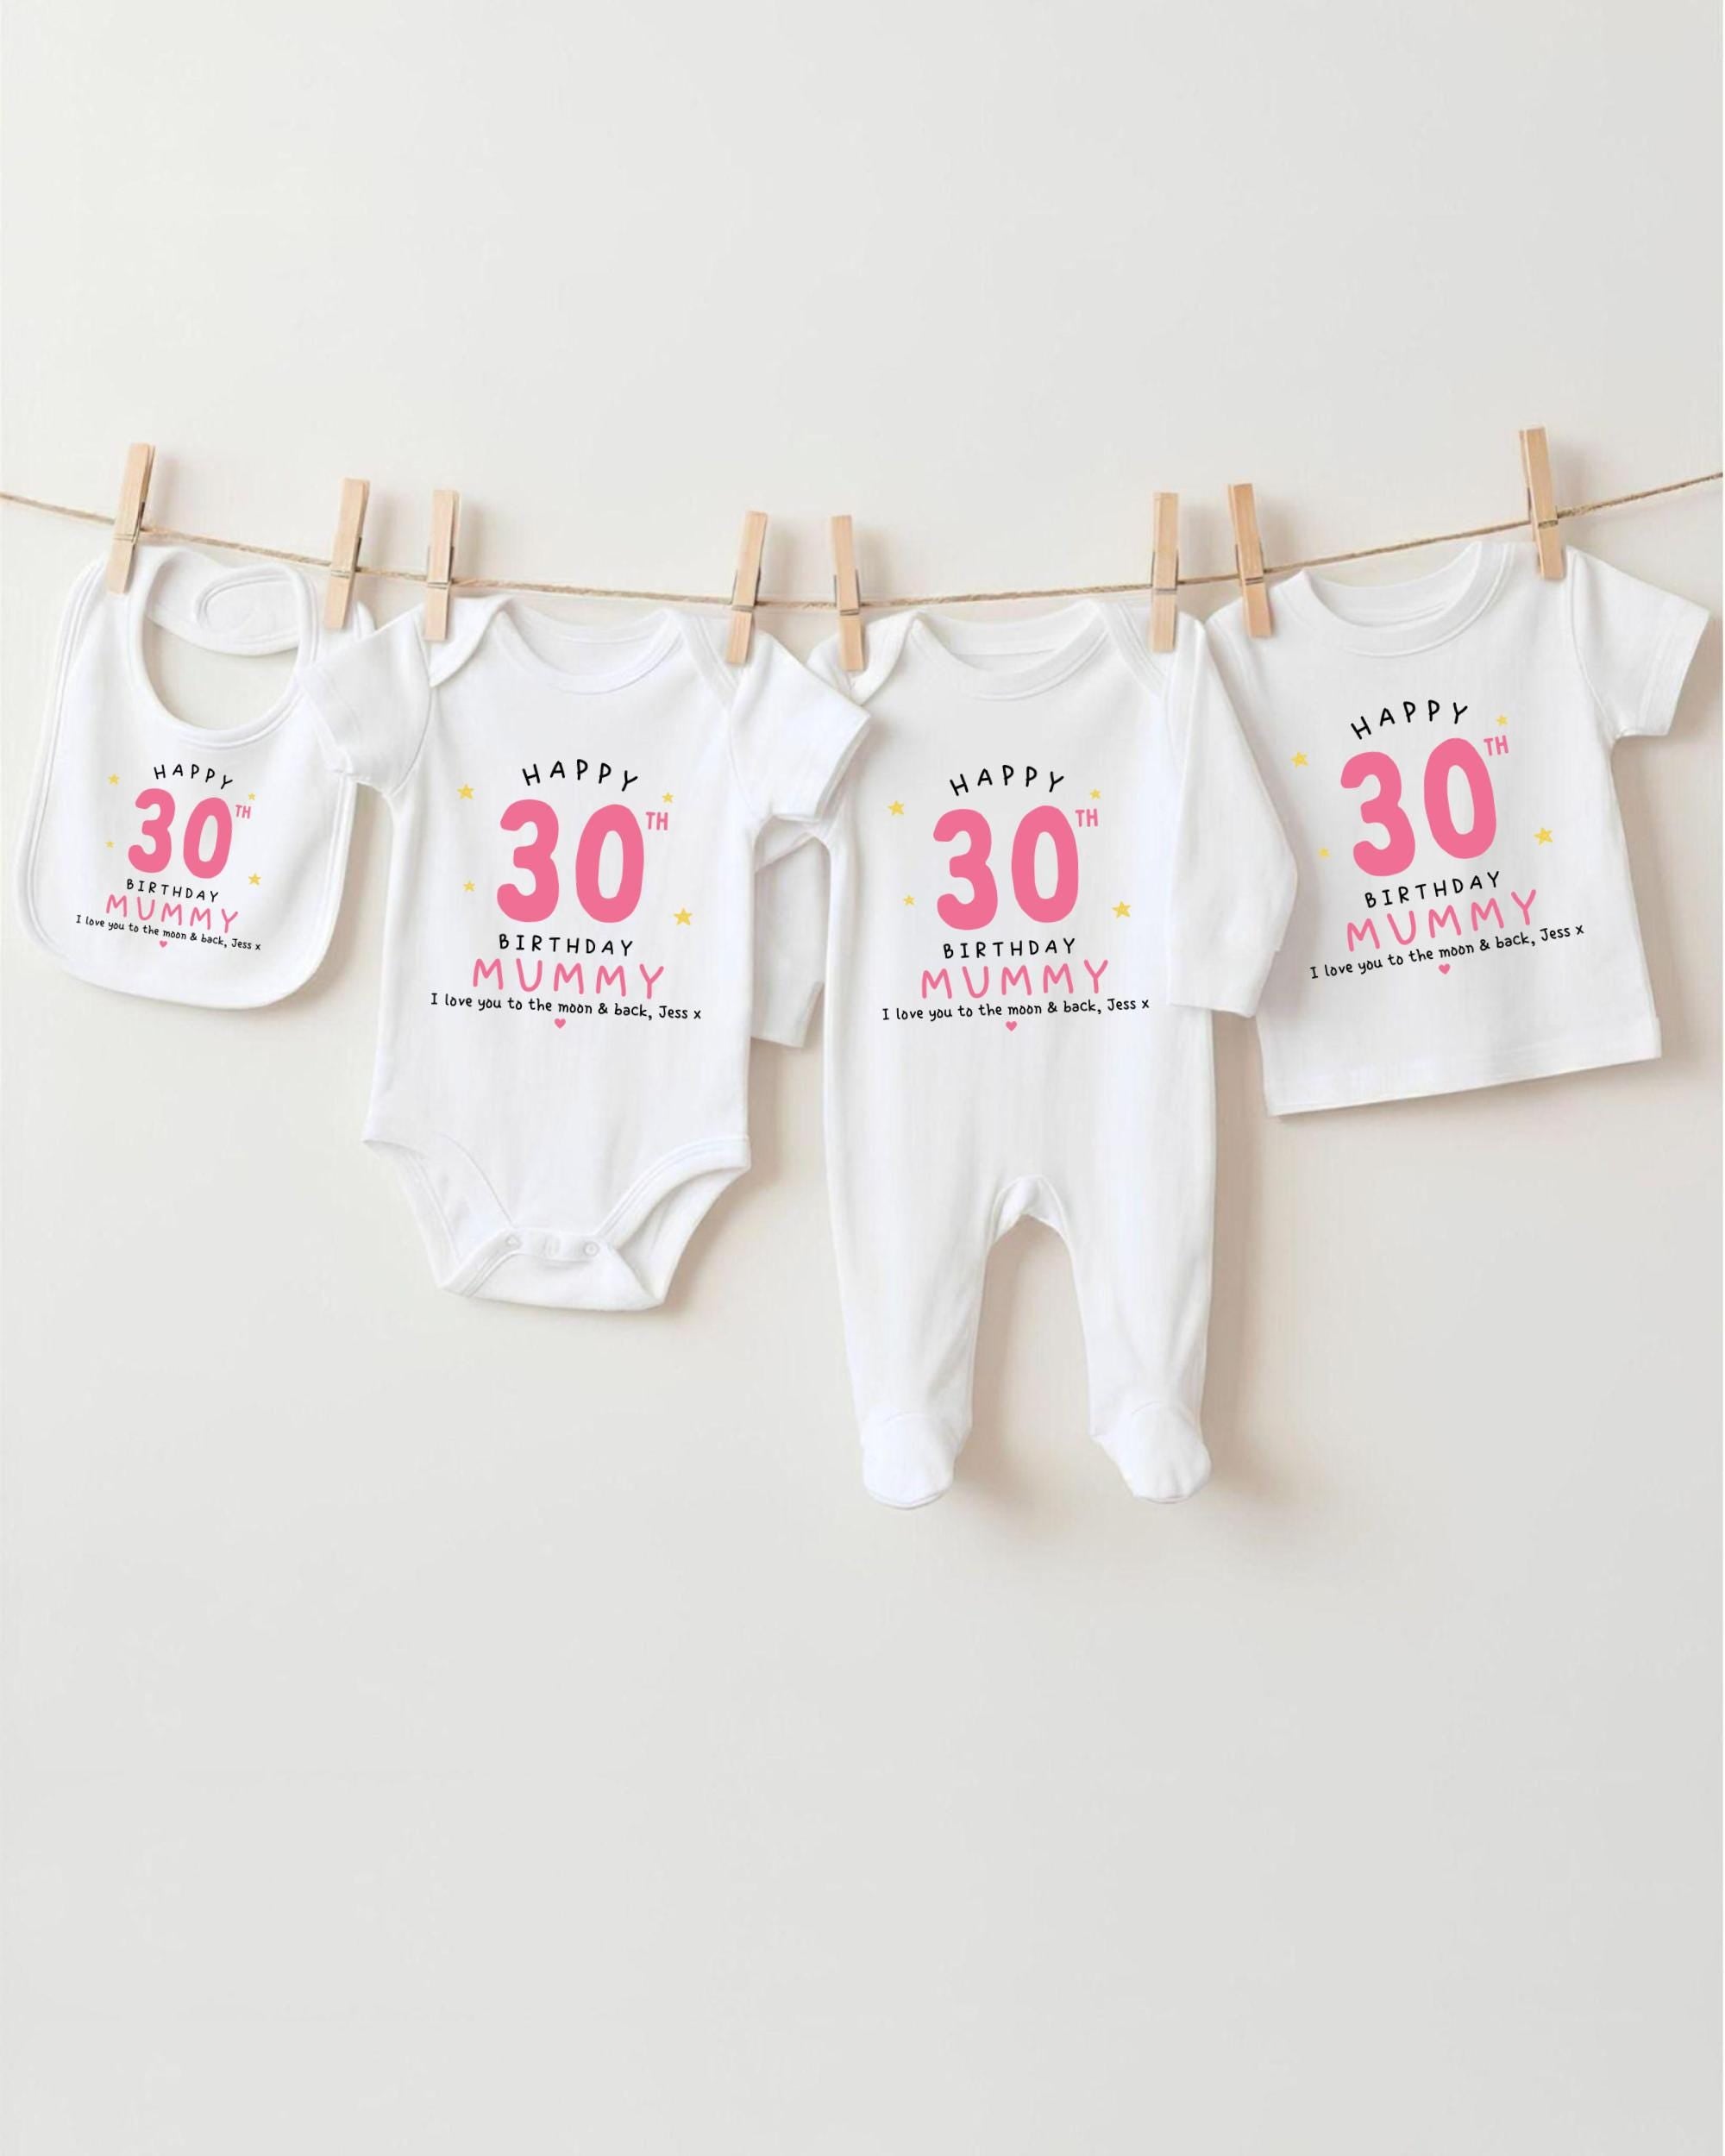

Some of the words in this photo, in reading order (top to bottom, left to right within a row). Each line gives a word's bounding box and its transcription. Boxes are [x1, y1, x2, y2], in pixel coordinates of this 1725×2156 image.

[1350, 699, 1469, 741] HAPPY
[153, 763, 234, 790] HAPPY
[522, 758, 638, 793] HAPPY
[949, 764, 1065, 797] HAPPY
[126, 878, 219, 903] BIRTHDAY
[1364, 870, 1500, 909] BIRTHDAY
[105, 893, 238, 933] MUMMY
[1346, 888, 1537, 953] MUMMY
[76, 914, 82, 924] I
[85, 916, 105, 928] love
[108, 921, 125, 931] you
[128, 922, 140, 933] to
[142, 924, 160, 936] the
[162, 930, 187, 940] moon
[189, 931, 198, 942] &
[200, 933, 228, 949] back,
[231, 937, 252, 950] Jess
[499, 933, 633, 957] BIRTHDAY
[943, 937, 1076, 960] BIRTHDAY
[1308, 965, 1319, 980] I
[1324, 962, 1353, 977] love
[1357, 958, 1383, 975] you
[1387, 953, 1404, 966] to
[1408, 948, 1434, 962] the
[1438, 944, 1475, 959] moon
[1479, 938, 1491, 952] &
[1494, 931, 1536, 950] back,
[1539, 927, 1571, 942] Jess
[1575, 924, 1584, 936] x
[472, 958, 665, 1000] MUMMY
[920, 958, 1108, 1000] MUMMY
[430, 992, 438, 1006] I
[444, 993, 473, 1008] love
[477, 998, 502, 1012] you
[506, 997, 523, 1011] to
[528, 997, 553, 1012] the
[557, 1003, 593, 1015] moon
[598, 1002, 609, 1015] &
[614, 1002, 653, 1021] back,
[658, 1005, 688, 1019] Jess
[693, 1010, 701, 1020] x
[882, 1007, 890, 1021] I
[896, 1007, 924, 1020] love
[928, 1008, 953, 1022] you
[957, 1005, 974, 1018] to
[977, 1002, 1002, 1017] the
[1007, 1004, 1042, 1016] moon
[1047, 1000, 1058, 1014] &
[1063, 999, 1102, 1015] back,
[1107, 998, 1137, 1012] Jess
[1141, 999, 1150, 1009] x
